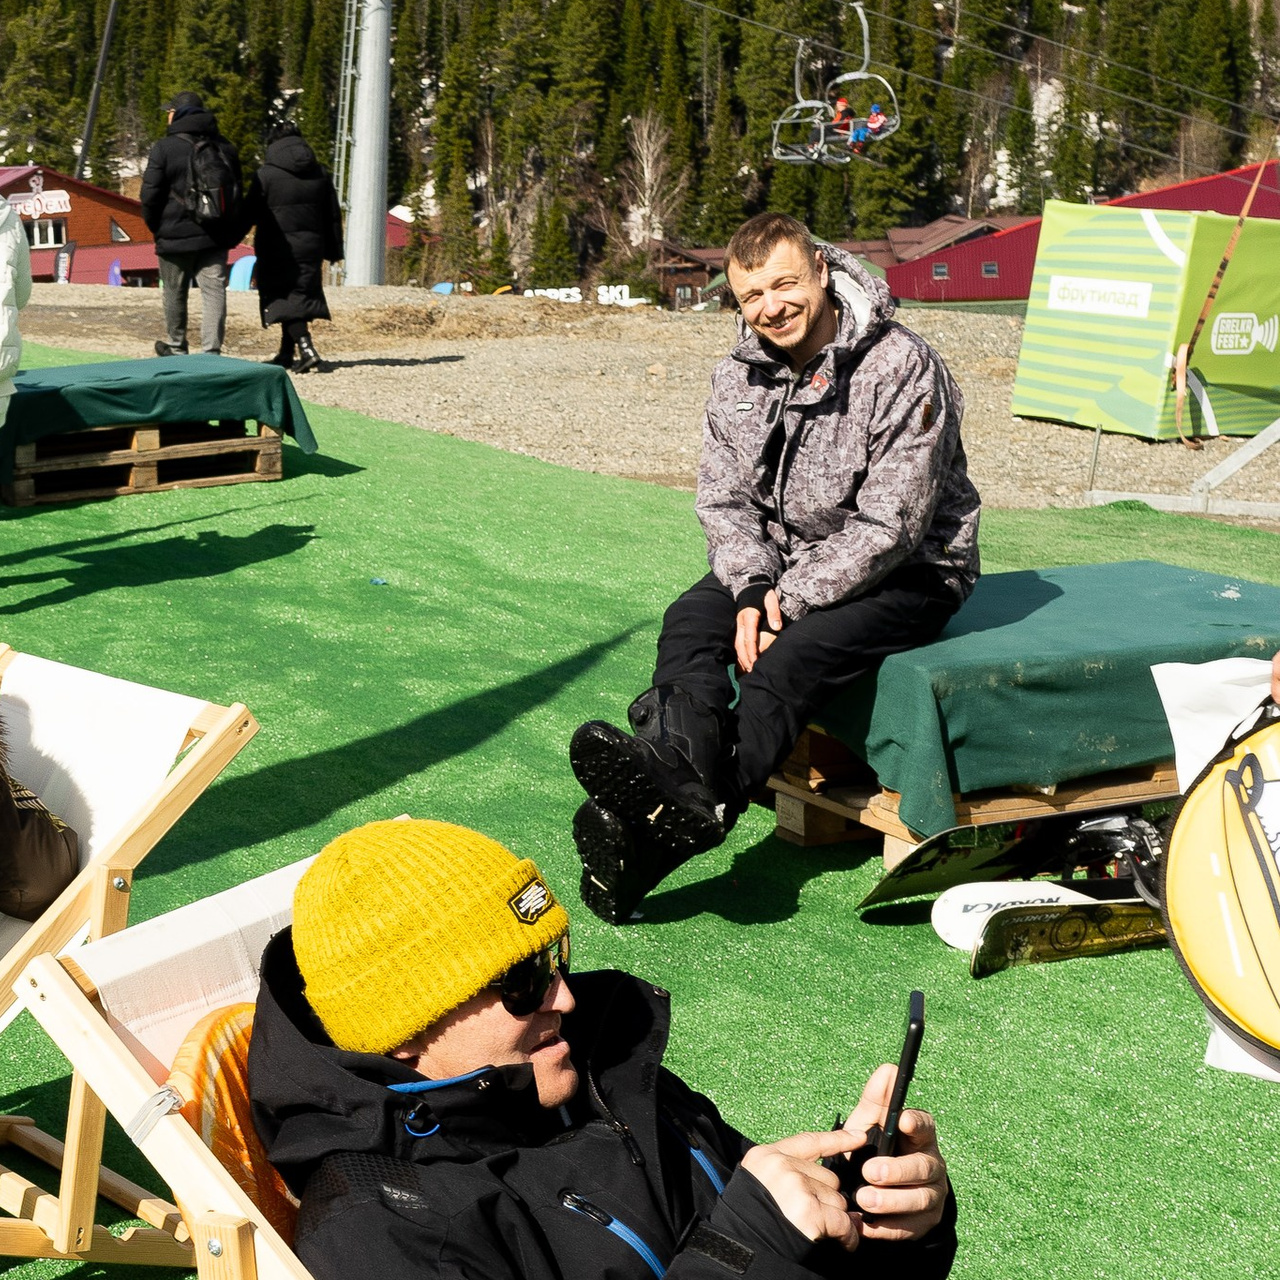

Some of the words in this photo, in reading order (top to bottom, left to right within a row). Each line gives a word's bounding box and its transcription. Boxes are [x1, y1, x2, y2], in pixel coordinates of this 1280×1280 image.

[1057, 281, 1140, 309] фрутилад
[1219, 318, 1253, 334] GRELKA
[1217, 333, 1241, 349] FEST
